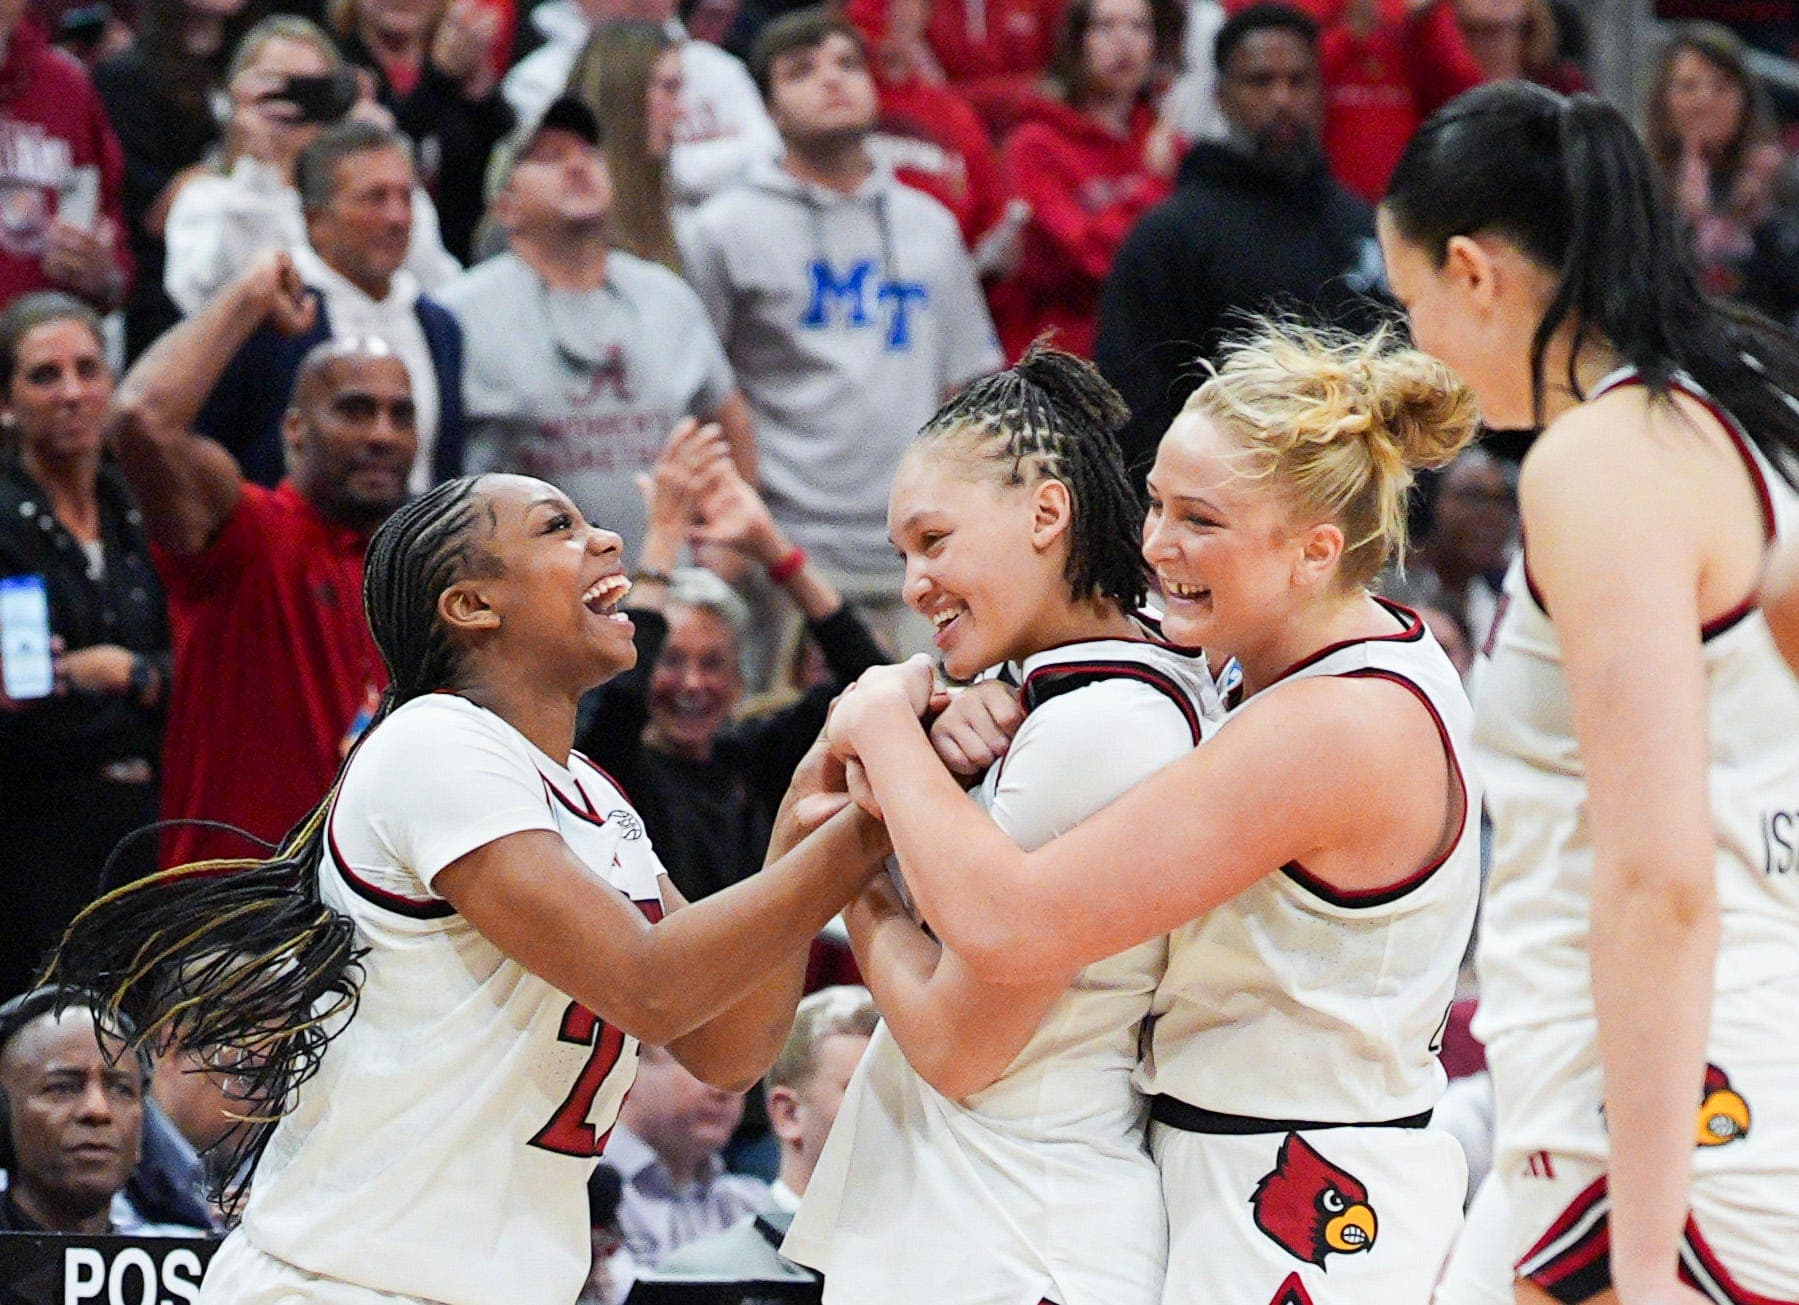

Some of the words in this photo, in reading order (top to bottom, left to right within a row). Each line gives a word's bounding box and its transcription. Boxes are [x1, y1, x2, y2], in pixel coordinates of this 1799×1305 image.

[1760, 810, 1799, 874] IS
[526, 1000, 641, 1158] 2
[64, 1247, 203, 1305] POS
